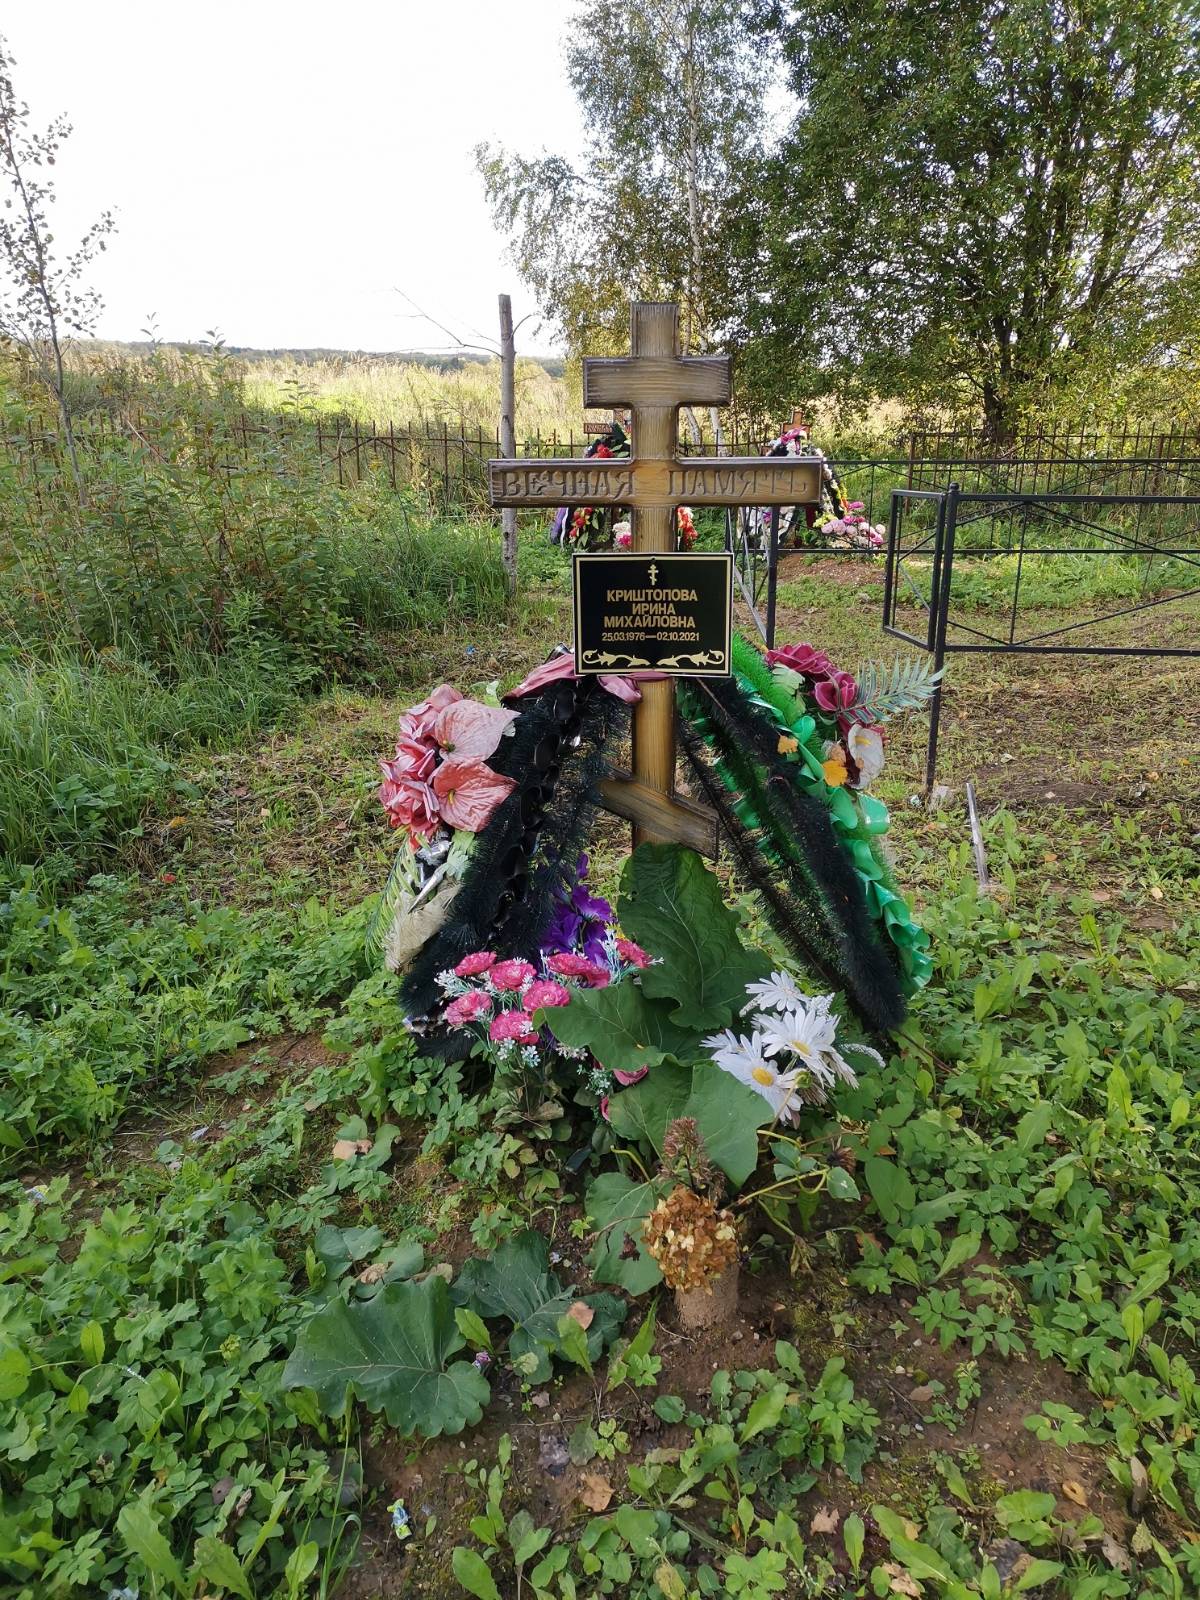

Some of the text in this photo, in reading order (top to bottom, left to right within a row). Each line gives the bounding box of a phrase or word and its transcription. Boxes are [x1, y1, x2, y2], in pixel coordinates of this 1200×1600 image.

[501, 469, 807, 500] ВЕЧНАЯ ПАМЯТЬ
[606, 589, 698, 602] КРИШТОПОВА
[632, 603, 676, 615] ИРИНА
[603, 614, 696, 628] МИХАЙЛОВНА
